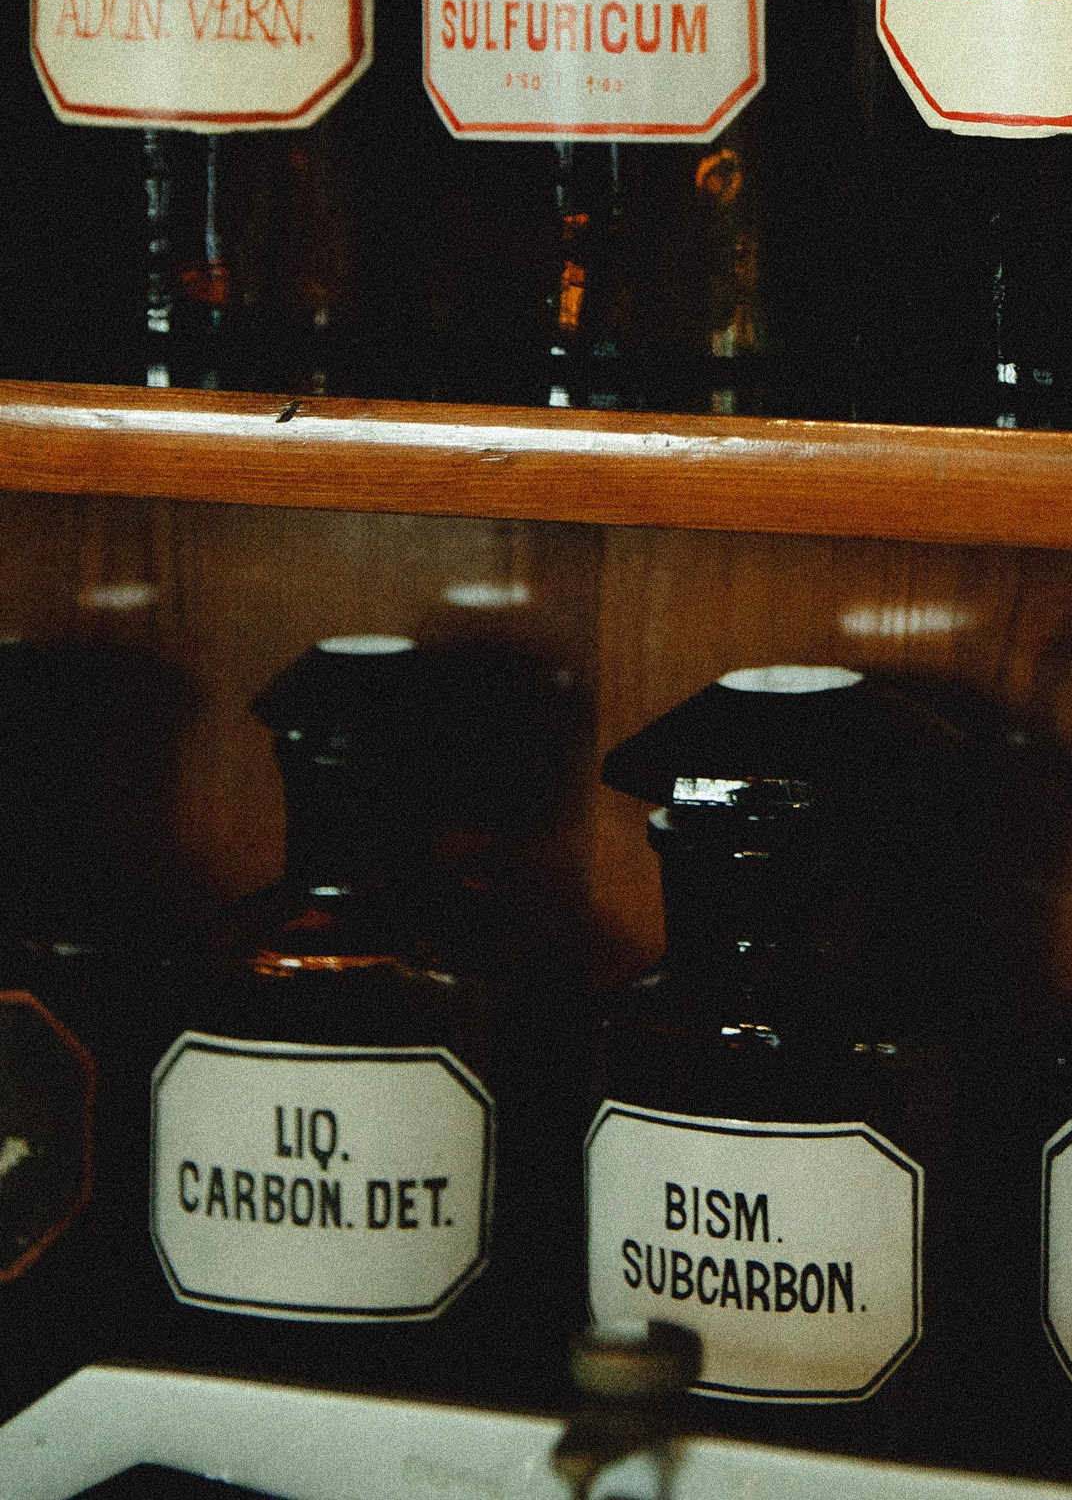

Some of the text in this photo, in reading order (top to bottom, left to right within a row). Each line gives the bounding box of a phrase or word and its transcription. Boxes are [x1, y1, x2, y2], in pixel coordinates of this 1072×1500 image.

[441, 0, 708, 54] SULFURICUM
[275, 1104, 350, 1171] LIQ.
[178, 1160, 455, 1230] CARBON. DET.
[663, 1181, 784, 1244] BISM.
[621, 1239, 867, 1314] SUBCARBON.
